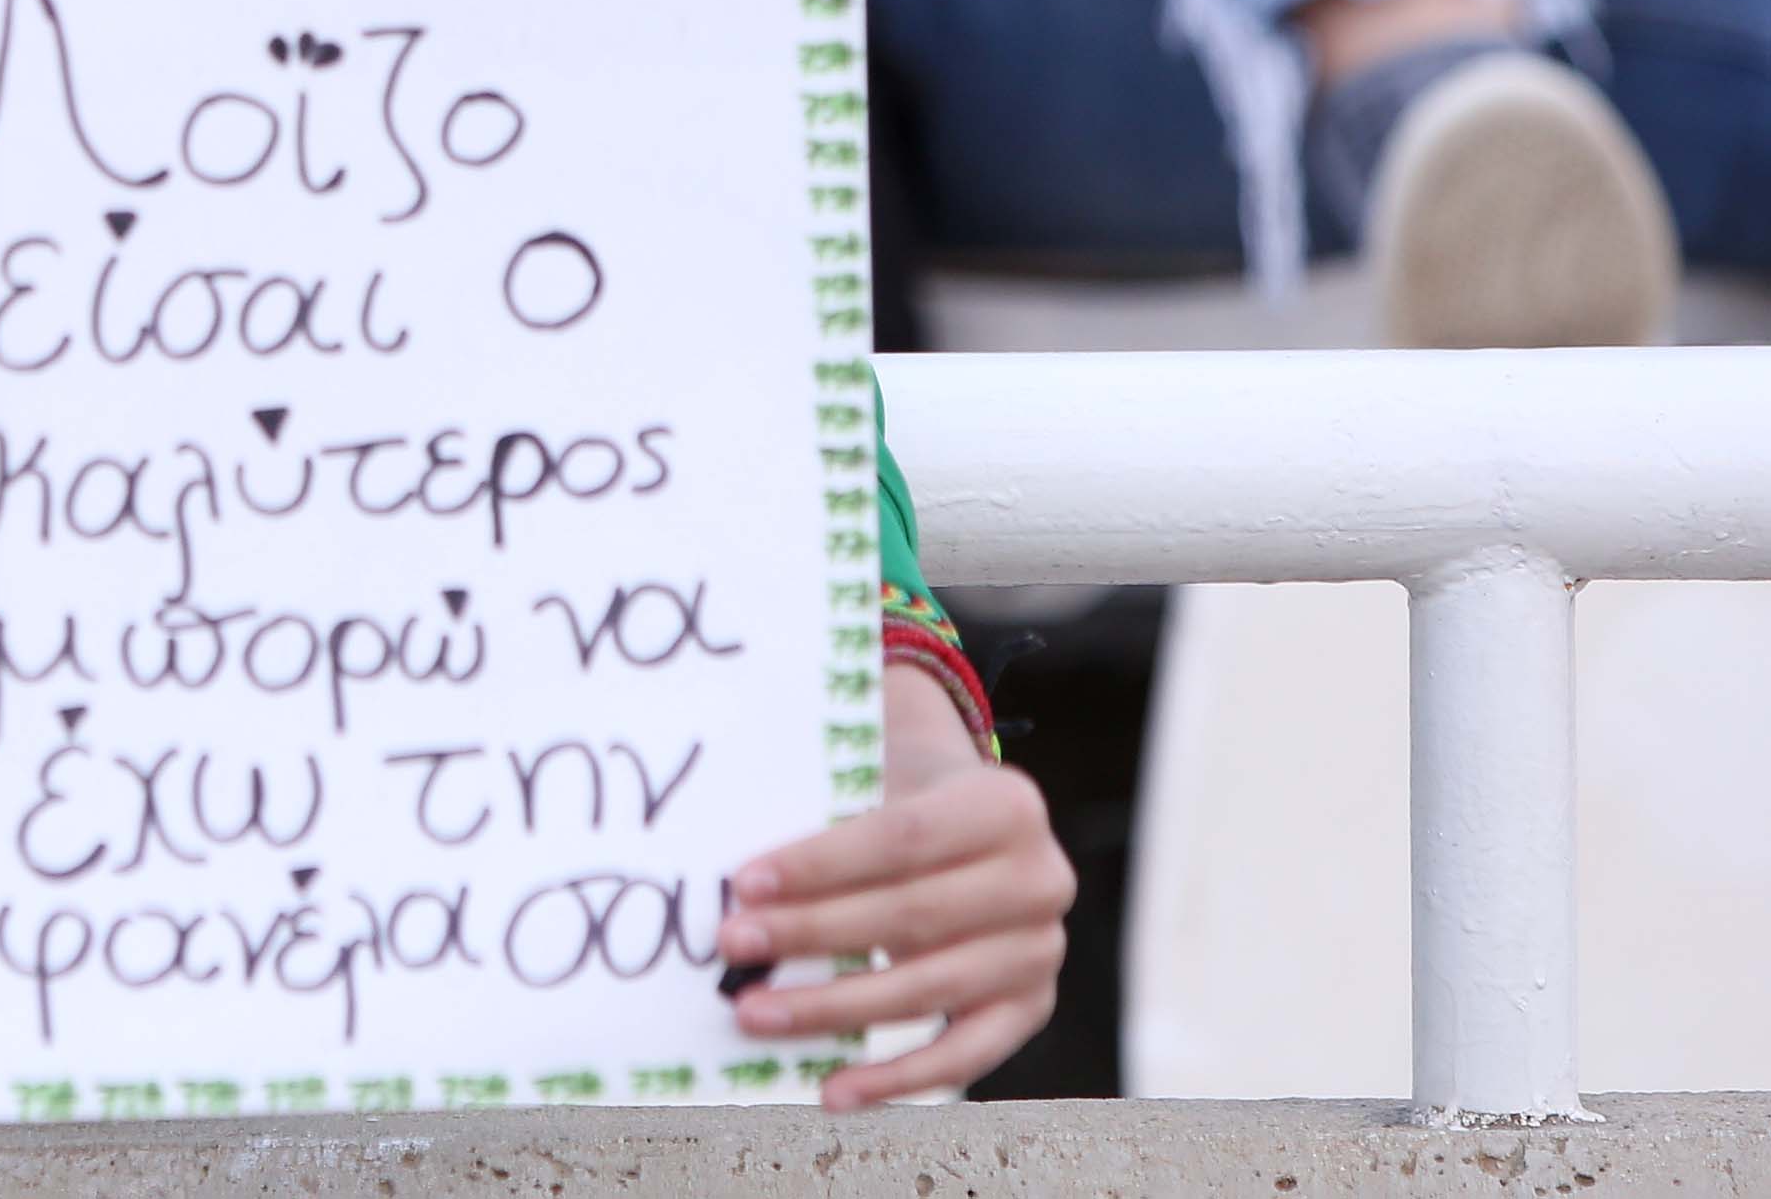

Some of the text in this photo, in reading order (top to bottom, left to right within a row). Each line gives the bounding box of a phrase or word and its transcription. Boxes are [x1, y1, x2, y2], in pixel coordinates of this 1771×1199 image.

[533, 580, 743, 669] να
[17, 704, 702, 881] έχω την
